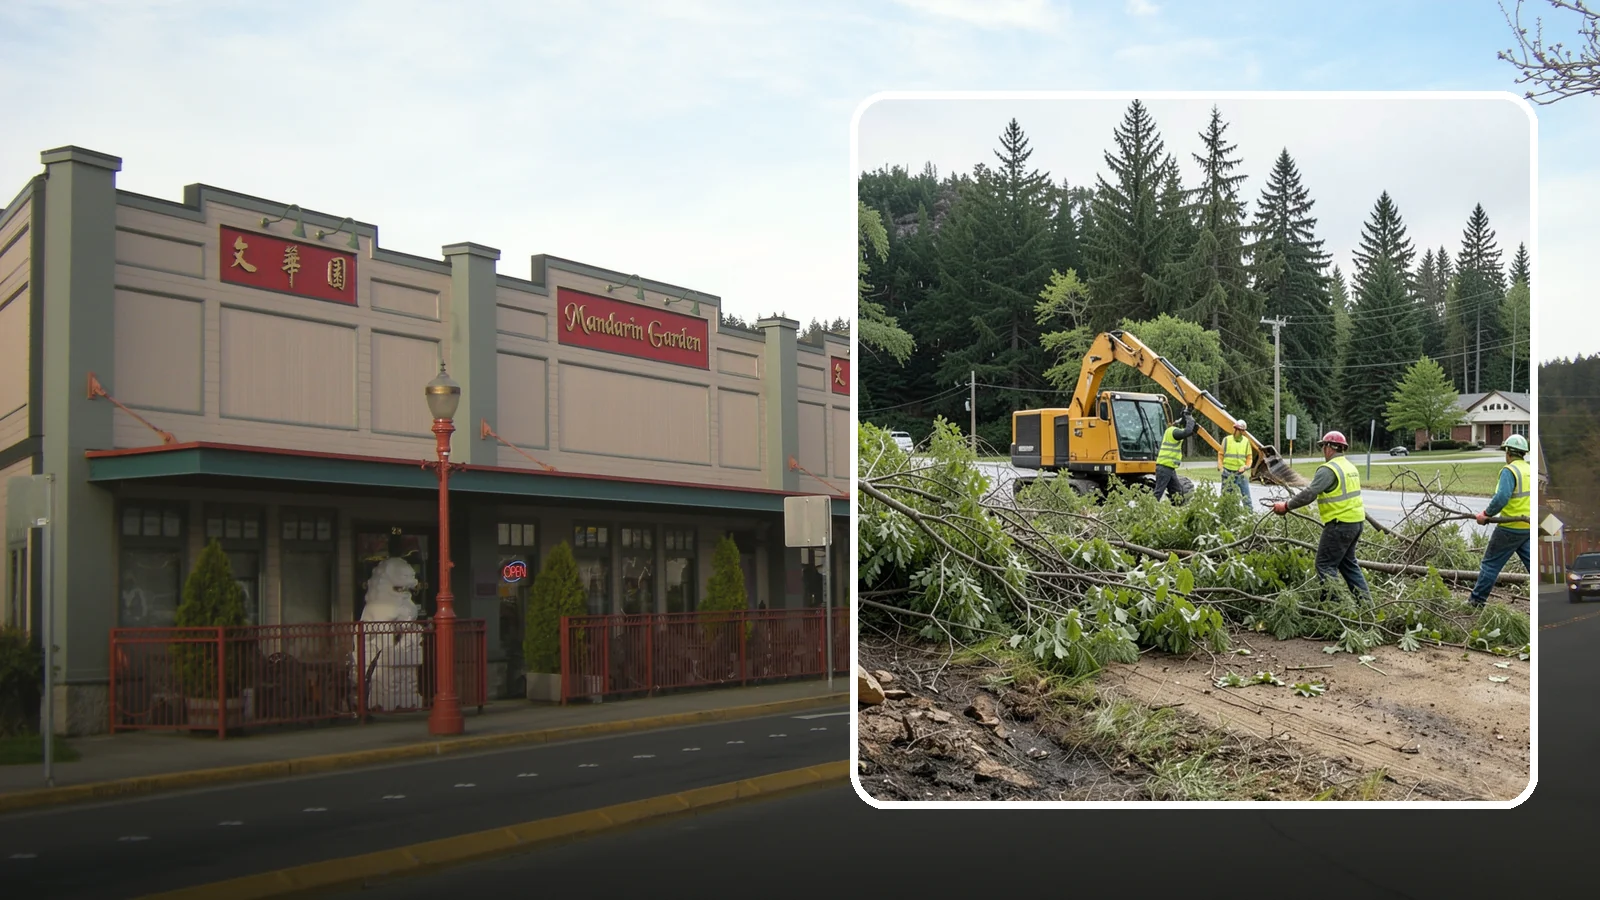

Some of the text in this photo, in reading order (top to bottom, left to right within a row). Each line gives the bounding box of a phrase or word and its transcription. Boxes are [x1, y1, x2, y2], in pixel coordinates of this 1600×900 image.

[231, 236, 346, 291] 文華園
[564, 302, 701, 352] Mandarin Garden
[503, 565, 527, 578] OPEN
